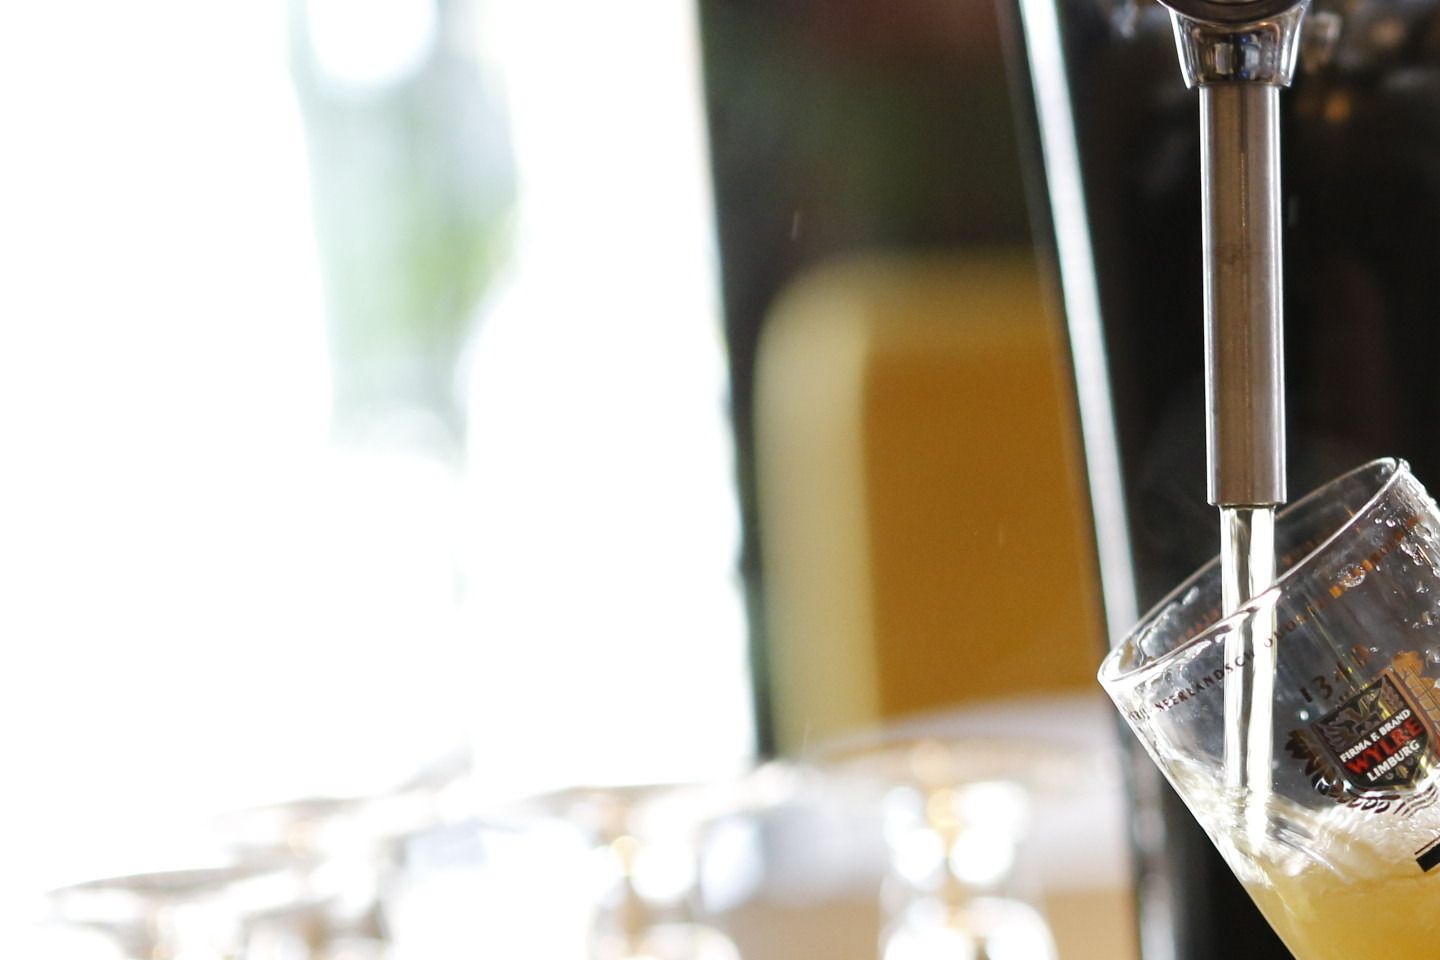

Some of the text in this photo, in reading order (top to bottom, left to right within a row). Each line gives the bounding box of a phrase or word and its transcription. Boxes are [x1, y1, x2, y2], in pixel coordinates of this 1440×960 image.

[1339, 739, 1371, 763] FIRMA
[1378, 708, 1411, 736] BRAND
[1345, 718, 1422, 775] WYLRE
[1366, 740, 1421, 782] LIMBURG
